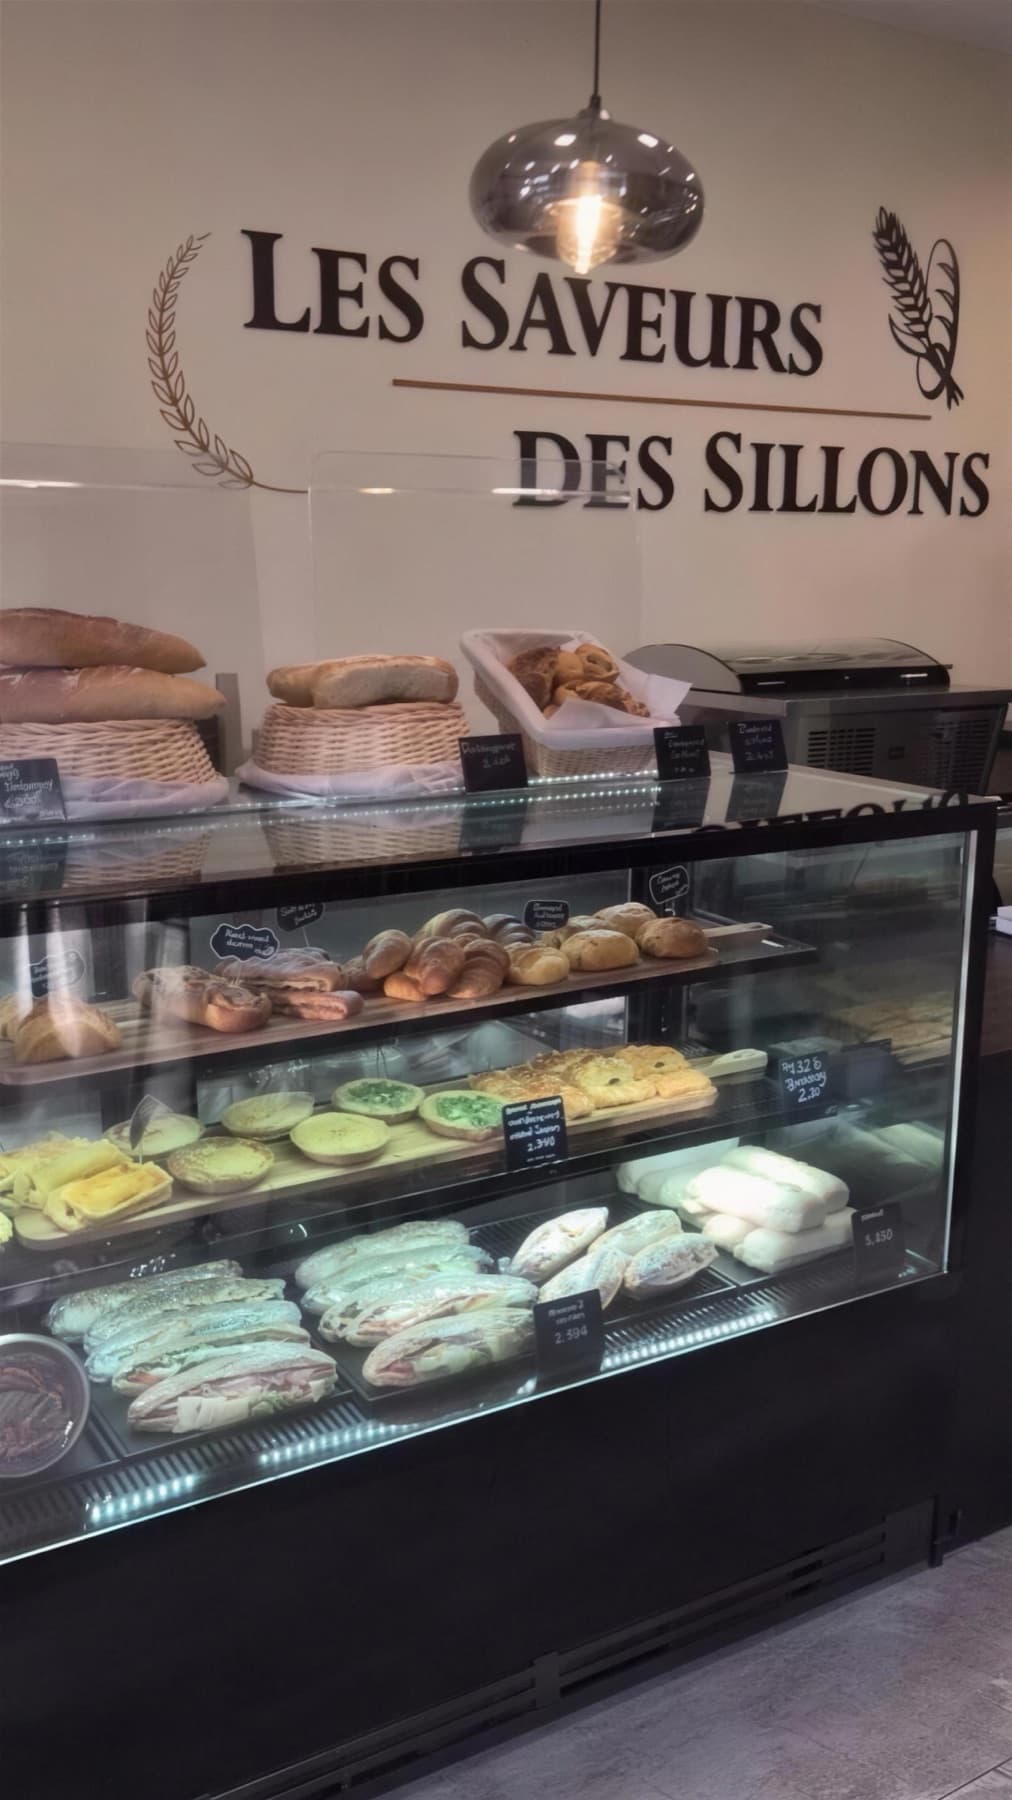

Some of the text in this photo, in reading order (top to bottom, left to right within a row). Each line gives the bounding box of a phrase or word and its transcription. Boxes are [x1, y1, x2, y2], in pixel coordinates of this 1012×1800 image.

[241, 229, 824, 377] LES SAVEURS
[512, 430, 991, 518] DES SILLONS
